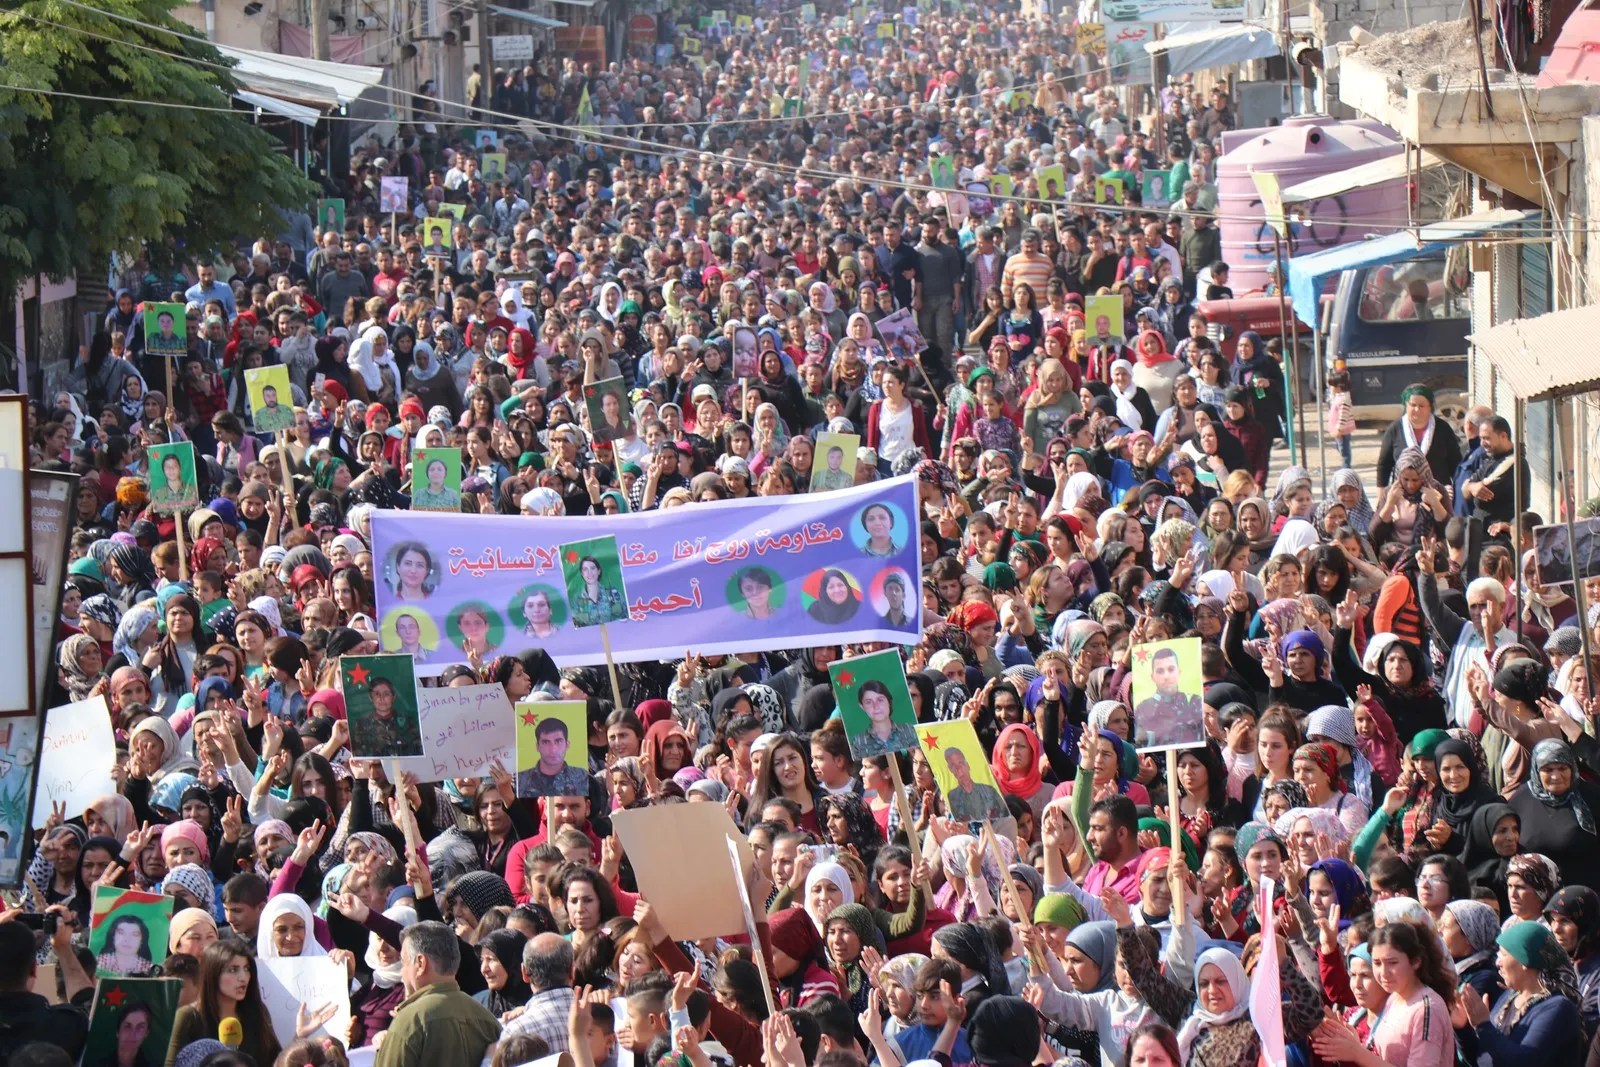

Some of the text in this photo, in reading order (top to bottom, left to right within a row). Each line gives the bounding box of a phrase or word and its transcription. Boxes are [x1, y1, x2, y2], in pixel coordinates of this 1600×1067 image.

[673, 536, 707, 561] آفا
[705, 537, 750, 563] روج
[754, 522, 844, 556] مقاومة
[448, 545, 559, 577] لإنسانية
